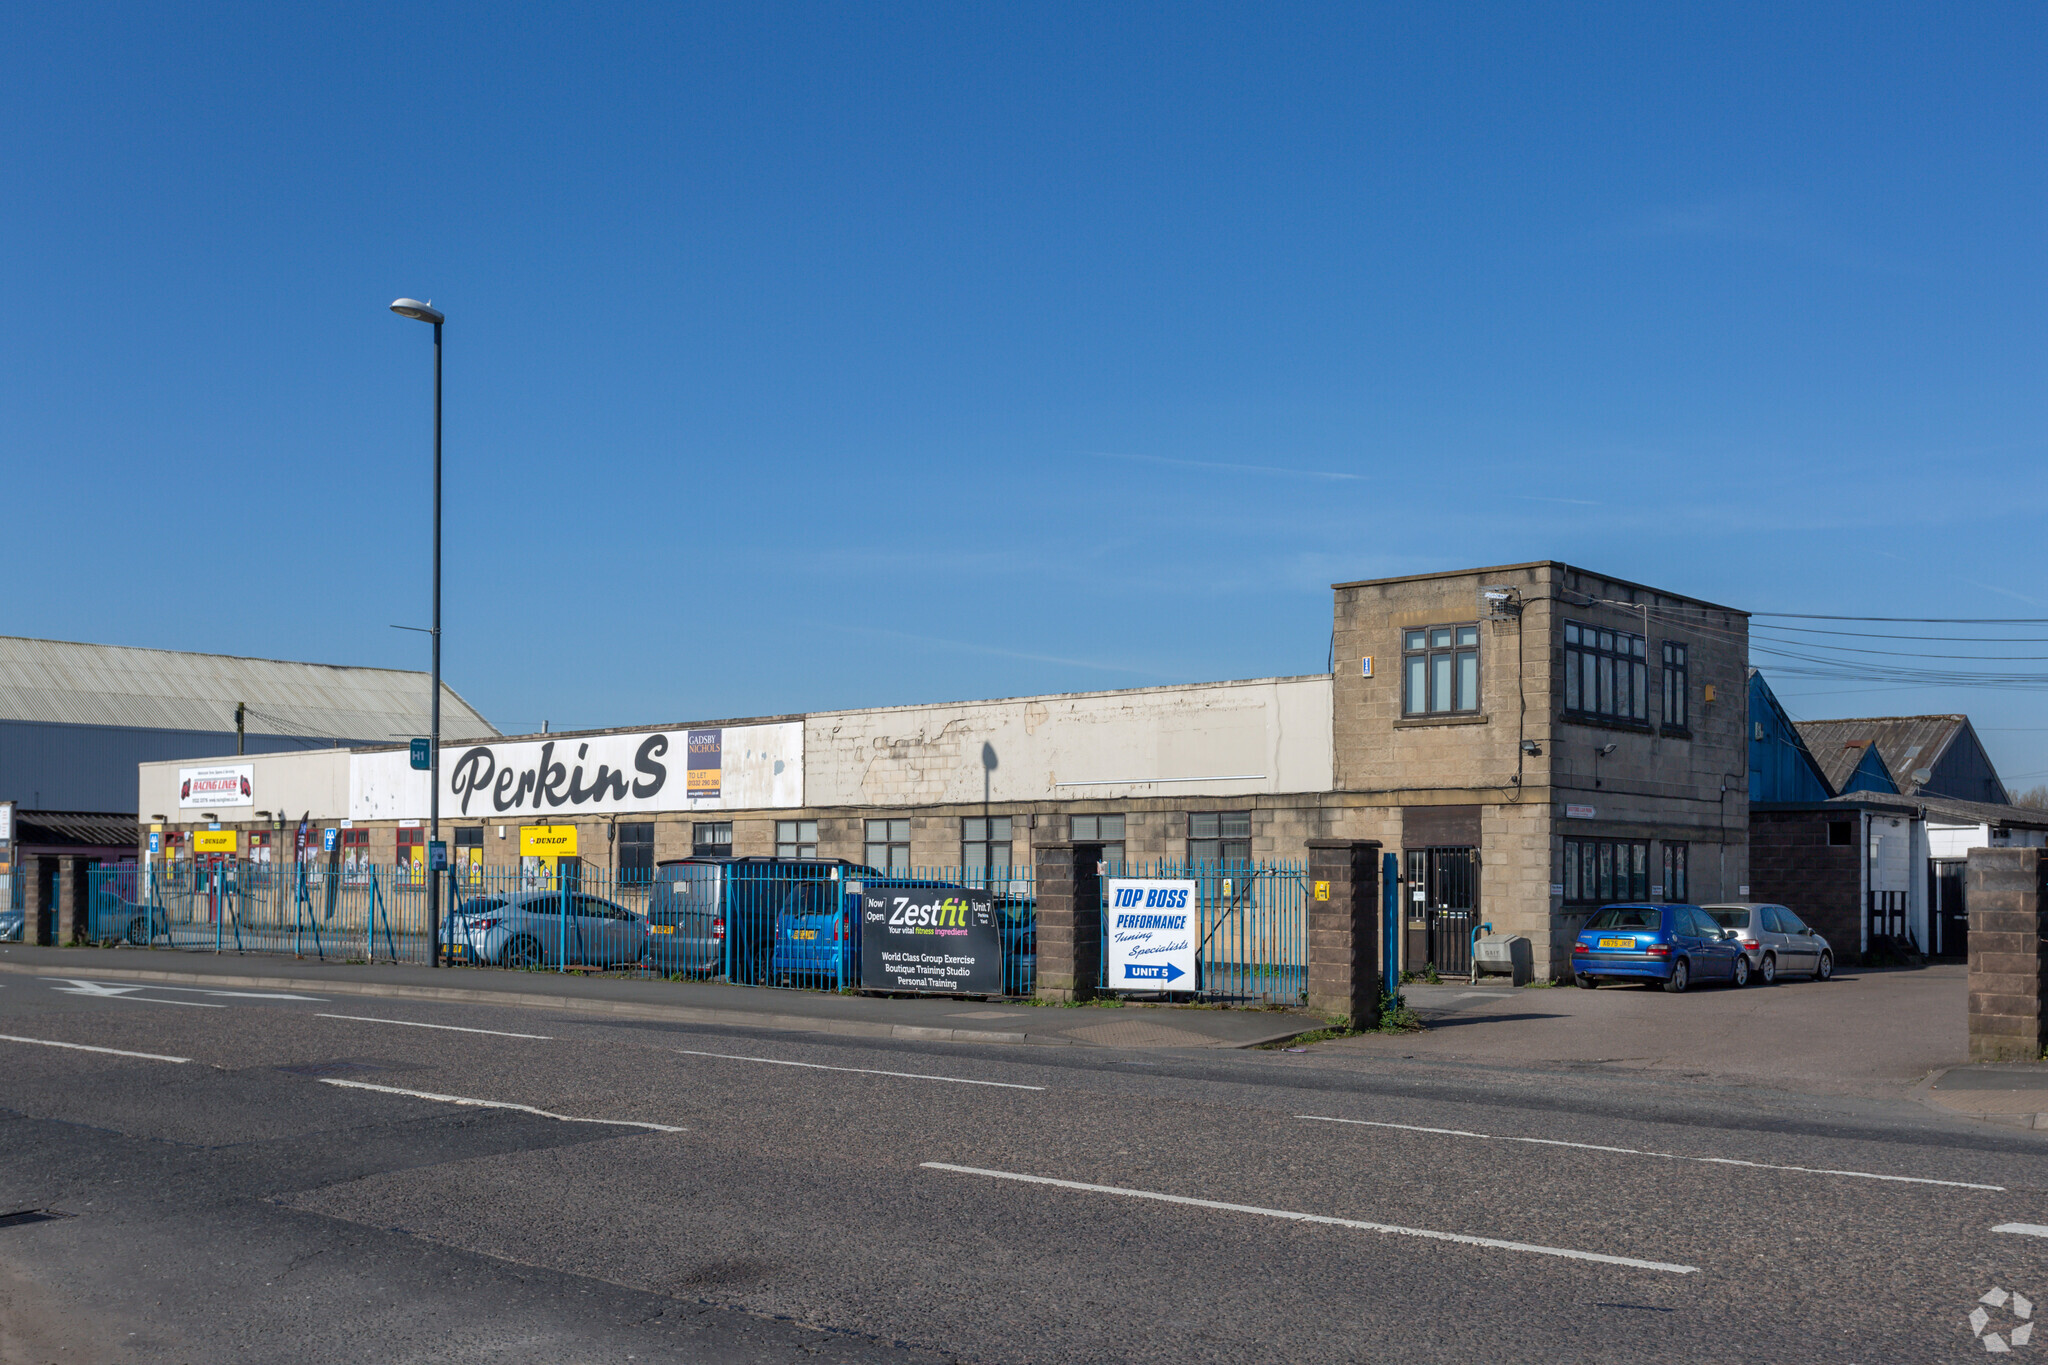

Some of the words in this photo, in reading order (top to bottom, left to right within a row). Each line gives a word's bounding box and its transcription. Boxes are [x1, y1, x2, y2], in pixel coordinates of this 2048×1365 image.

[688, 735, 716, 745] GADSBY
[689, 743, 721, 753] NICHOLS
[412, 751, 424, 761] H1
[697, 771, 707, 779] LET
[193, 780, 218, 791] RACING
[218, 779, 238, 790] LINES
[868, 899, 884, 908] Now
[1114, 888, 1144, 908] TOP
[1145, 888, 1189, 908] BOSS
[888, 897, 969, 927] Zestfit
[973, 902, 986, 912] Unit
[986, 902, 991, 912] 7
[866, 912, 885, 922] Open
[1116, 914, 1187, 929] PERFORMANCE
[888, 926, 901, 934] Your
[902, 926, 915, 934] vital
[915, 927, 934, 935] fitness
[935, 928, 968, 937] ingredient
[1114, 931, 1153, 943] Tuning
[1128, 940, 1189, 959] Specialists
[882, 952, 901, 961] World
[902, 952, 920, 962] Class
[921, 953, 943, 965] Group
[944, 955, 975, 964] Exercise
[885, 964, 915, 975] Boutique
[916, 965, 945, 977] Training
[946, 967, 970, 976] Studio
[1132, 967, 1159, 977] UNIT
[1161, 968, 1169, 977] 5
[897, 976, 927, 986] Personal
[928, 978, 957, 990] Training
